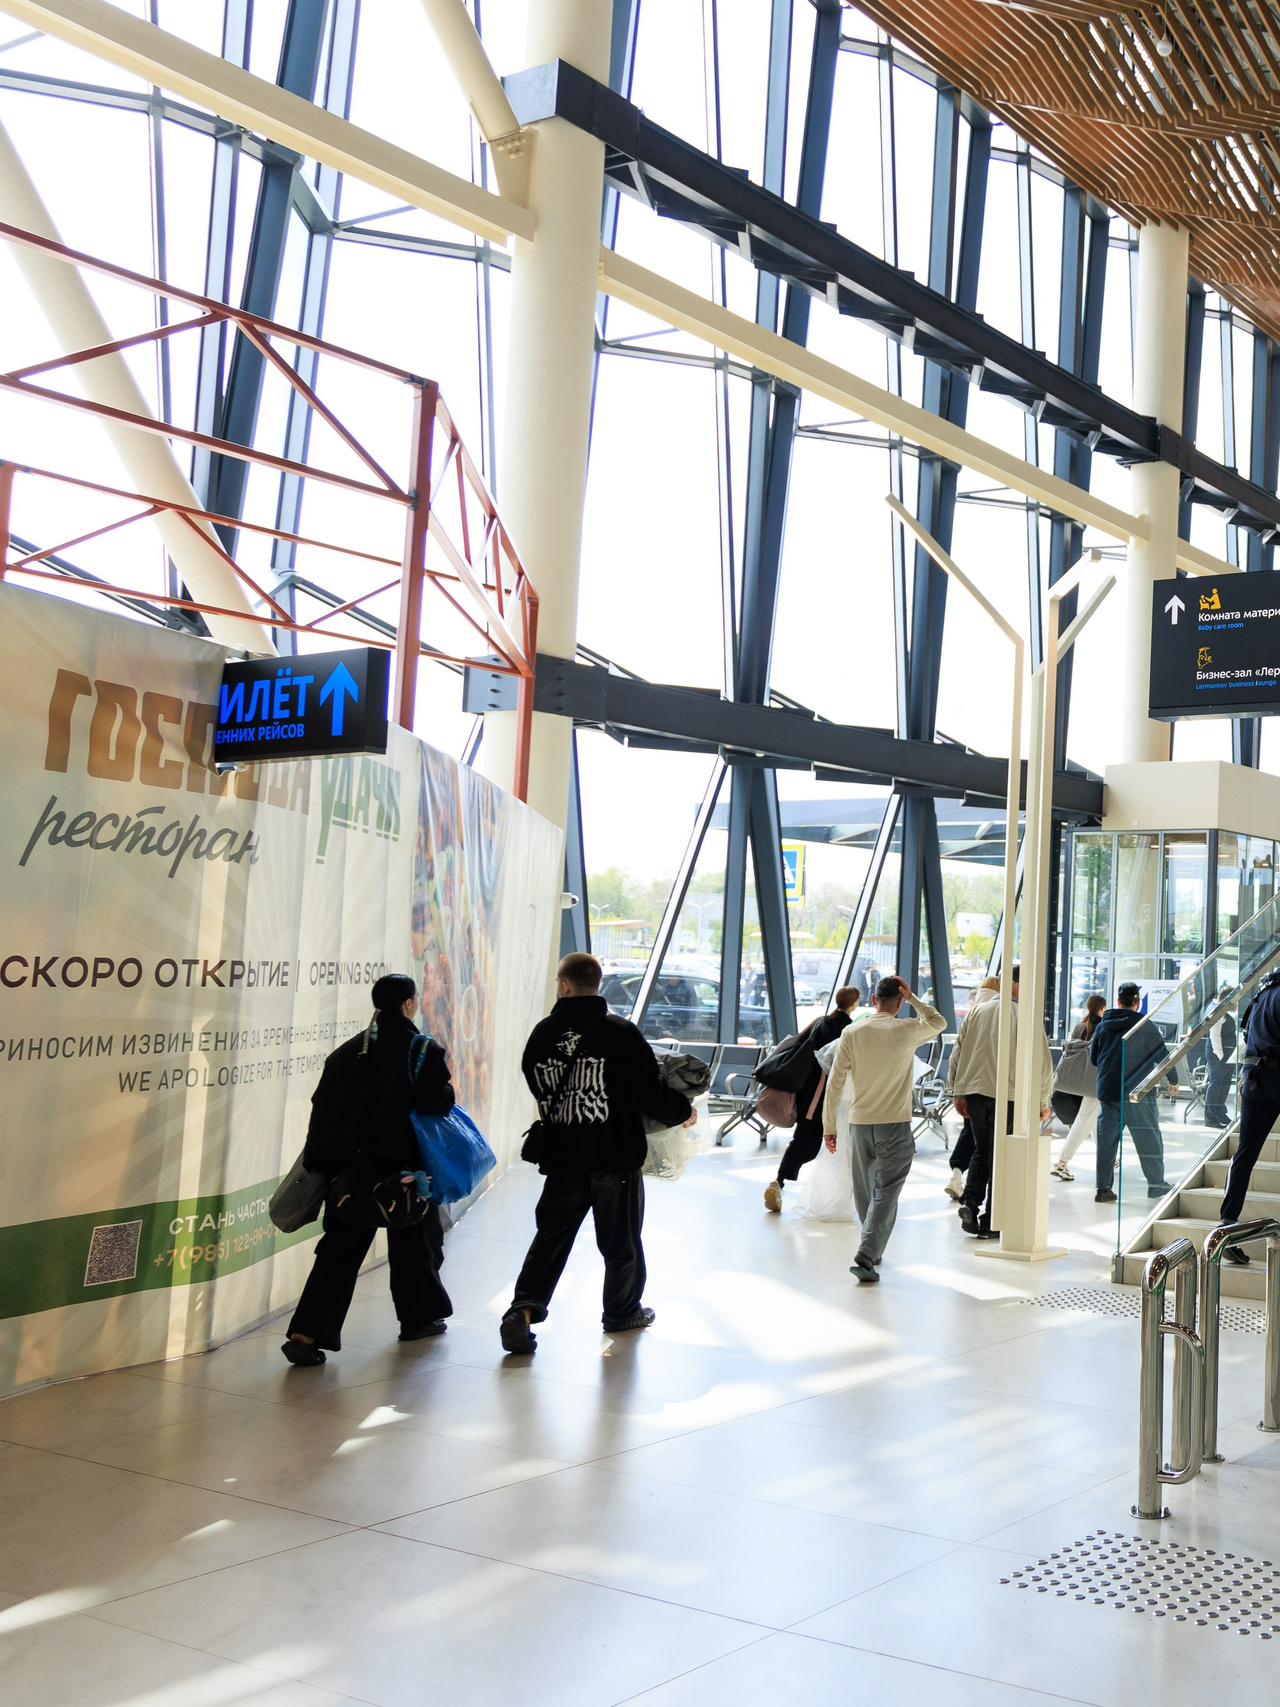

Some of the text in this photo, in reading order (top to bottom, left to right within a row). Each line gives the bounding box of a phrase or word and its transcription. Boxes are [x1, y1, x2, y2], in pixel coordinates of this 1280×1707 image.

[1197, 623, 1213, 631] Baby
[1198, 610, 1241, 622] Комната
[1195, 679, 1277, 690] Lermontov business lounge
[1196, 668, 1252, 680] Бизнес-зал
[258, 721, 305, 741] РЕЙСОВ
[18, 794, 260, 879] ресторан
[0, 954, 290, 989] СКОРО ОТКРЫТИЕ
[309, 961, 362, 987] OPENING
[121, 1030, 248, 1056] ИЗВИНЕНИЯ
[250, 1030, 261, 1049] ЗА
[263, 1023, 317, 1047] ВРЕМЕННЫЕ
[118, 1070, 152, 1093] WE
[157, 1063, 255, 1091] APOLOGIZE
[256, 1060, 273, 1082] FOR
[276, 1058, 293, 1077] THE
[168, 1208, 235, 1236] СТАНЬ
[153, 1239, 230, 1270] +7(985)
